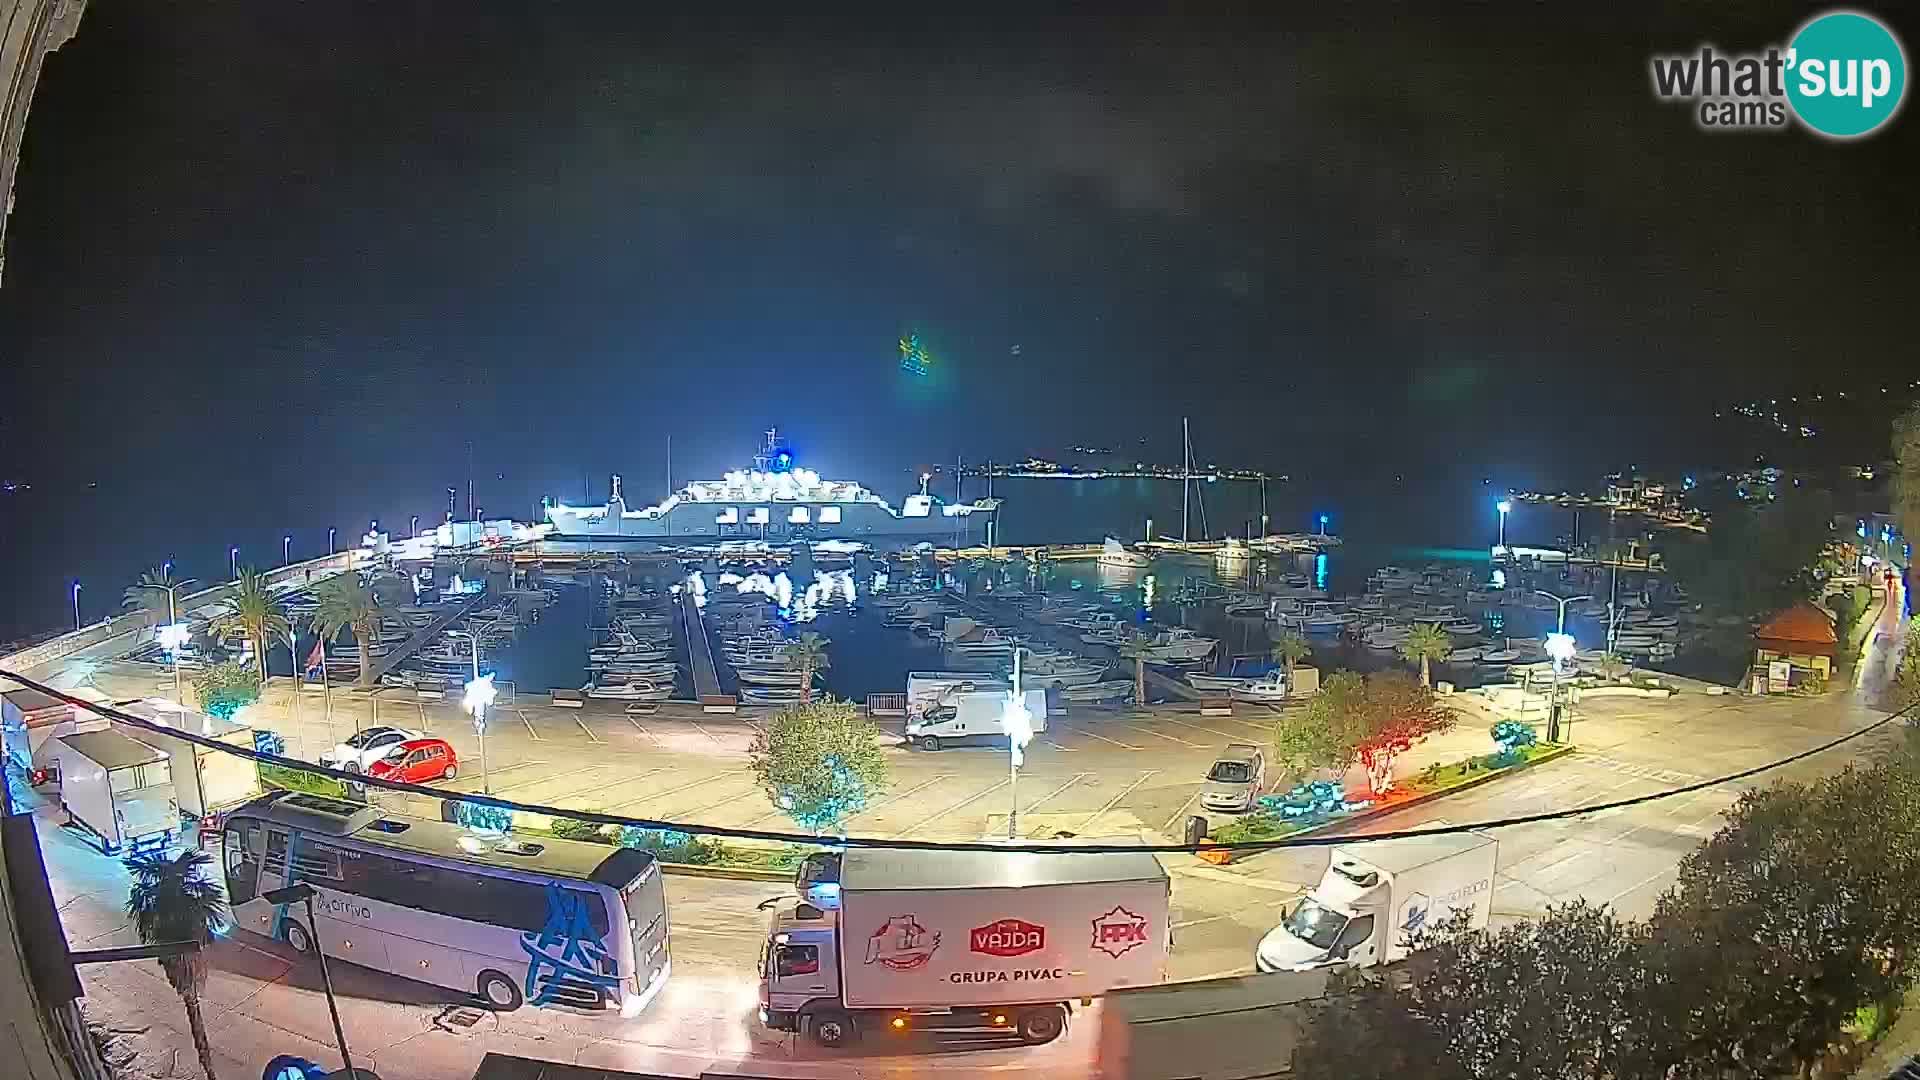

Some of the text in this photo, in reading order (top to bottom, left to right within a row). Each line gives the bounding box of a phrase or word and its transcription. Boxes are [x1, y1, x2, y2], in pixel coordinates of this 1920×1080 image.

[975, 931, 1041, 949] VAJDA
[1100, 922, 1147, 943] PPK
[950, 967, 1064, 984] GRUPA PIVAC
